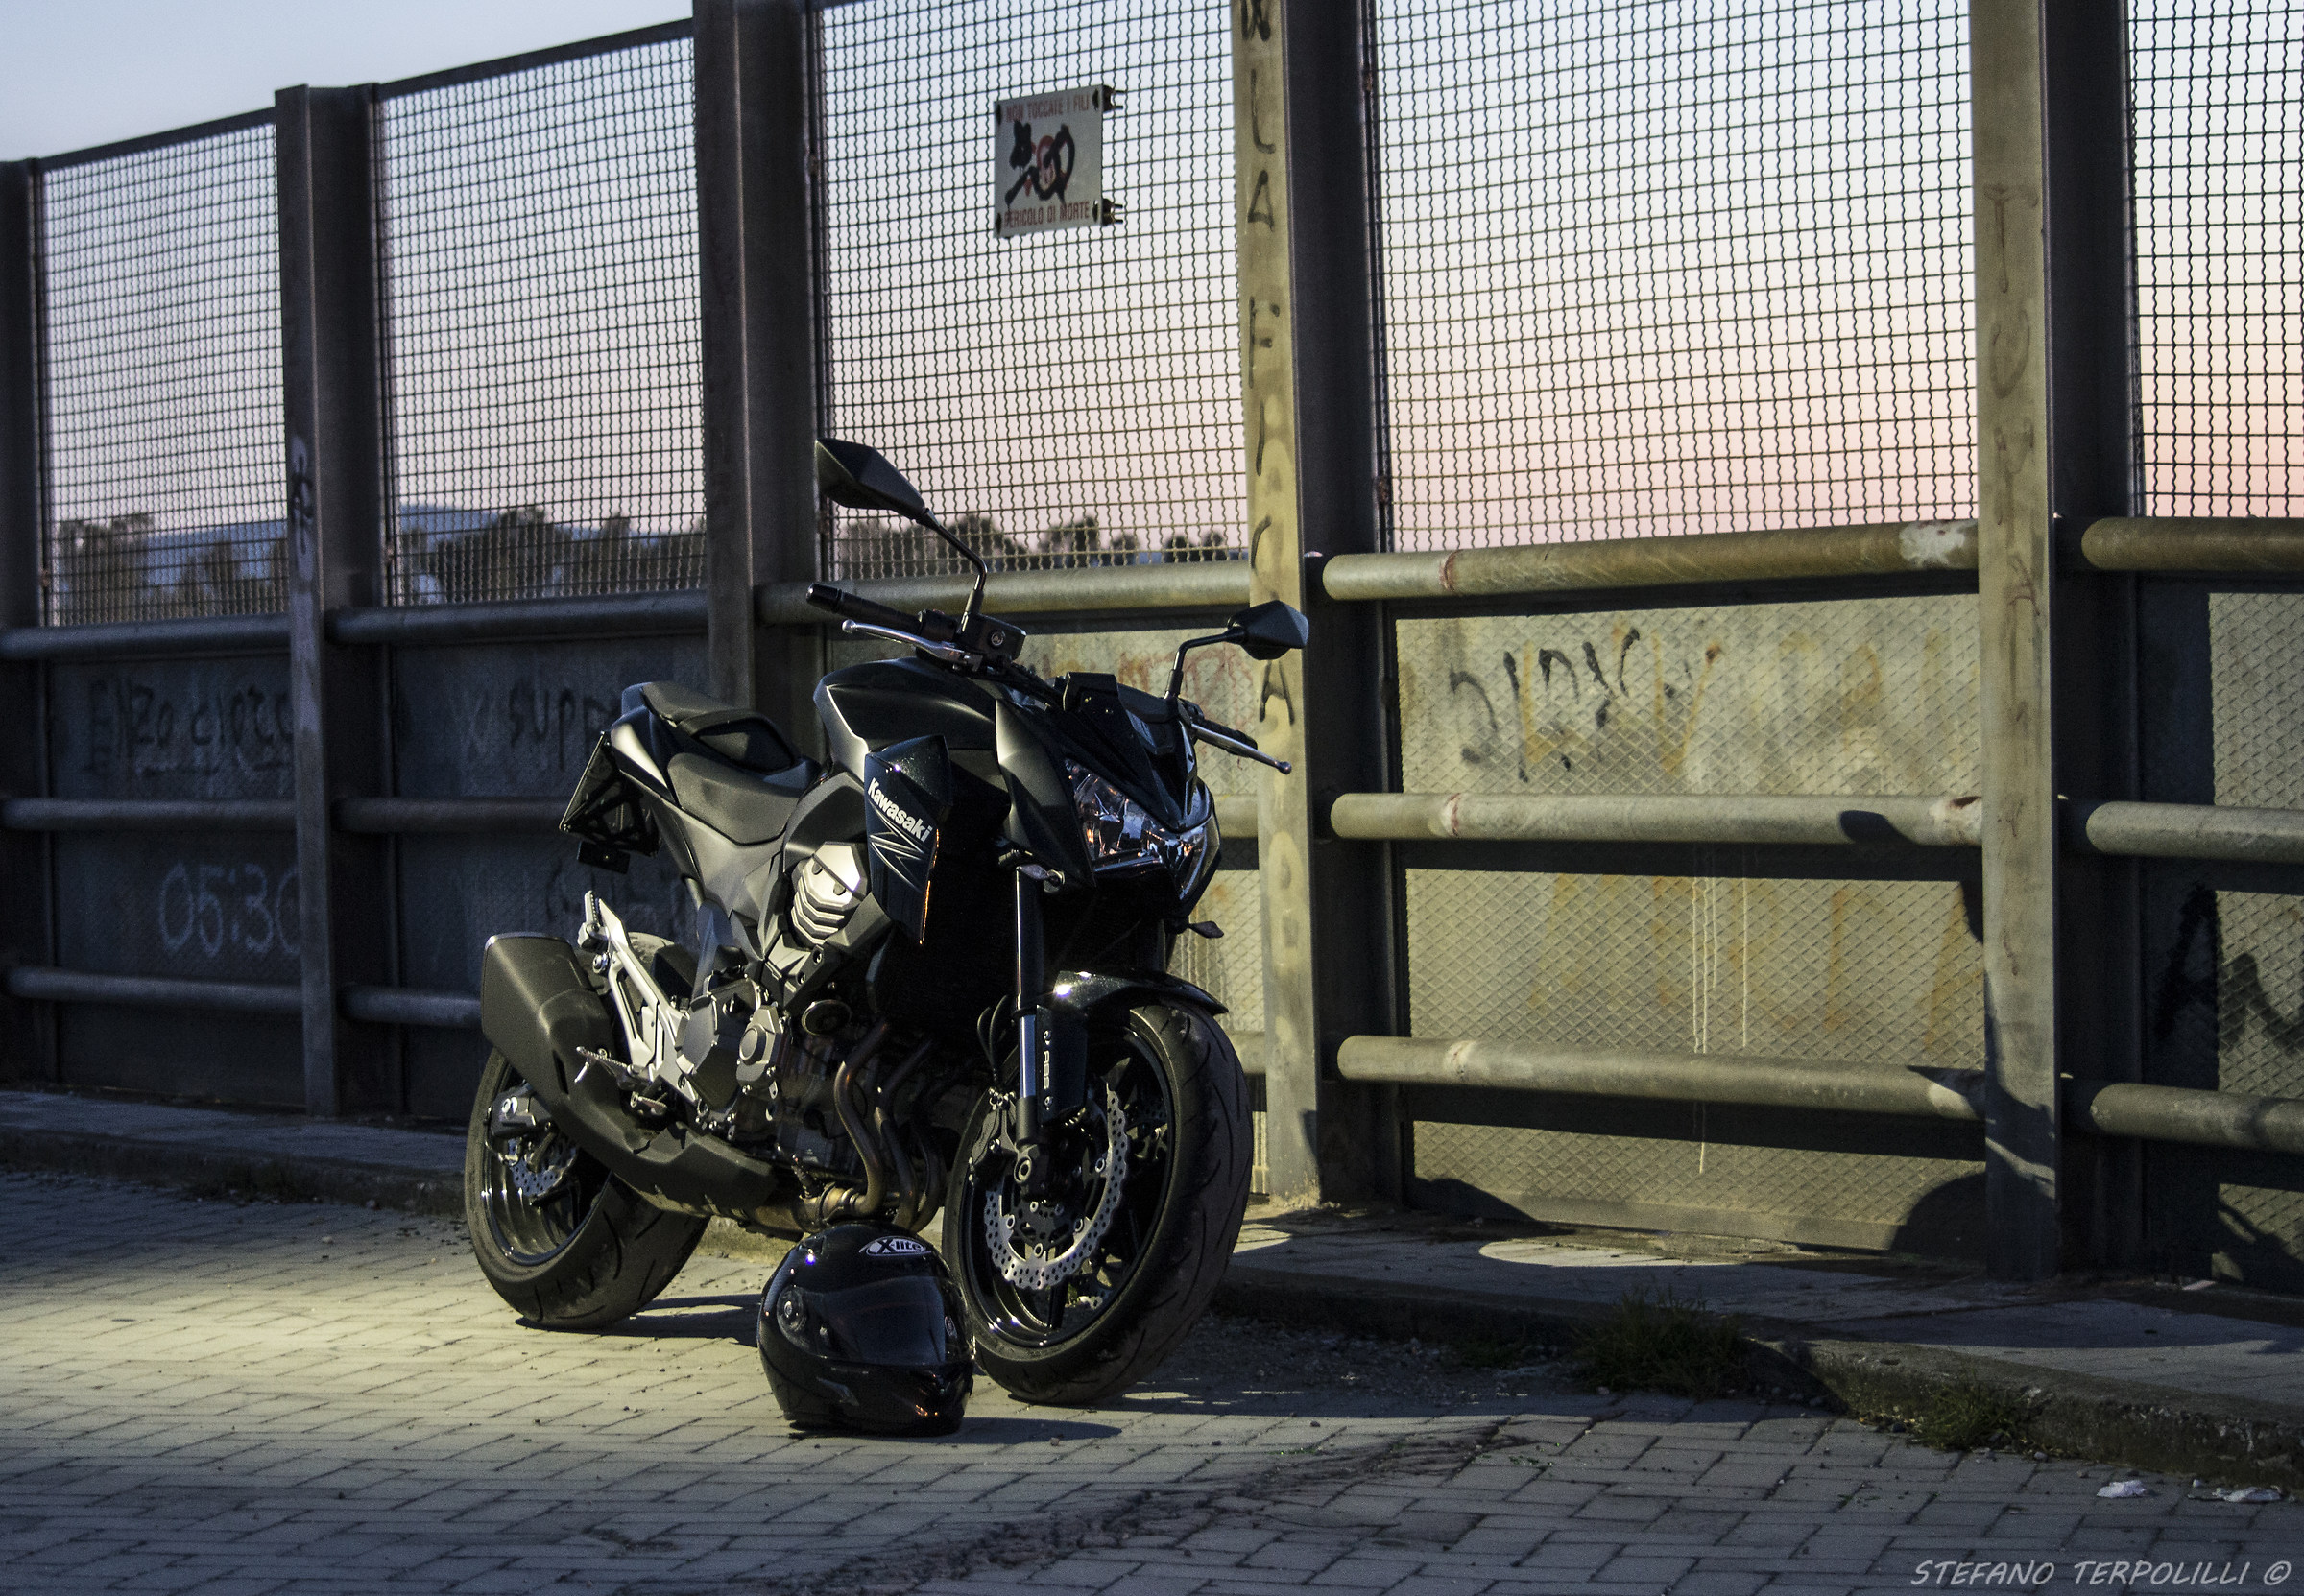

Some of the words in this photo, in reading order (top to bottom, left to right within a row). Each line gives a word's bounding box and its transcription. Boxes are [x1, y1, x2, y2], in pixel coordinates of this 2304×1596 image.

[1003, 206, 1044, 228] PERICOLO
[1046, 204, 1056, 224] DI
[1059, 201, 1091, 222] MORTE
[868, 777, 933, 843] Kawasaki
